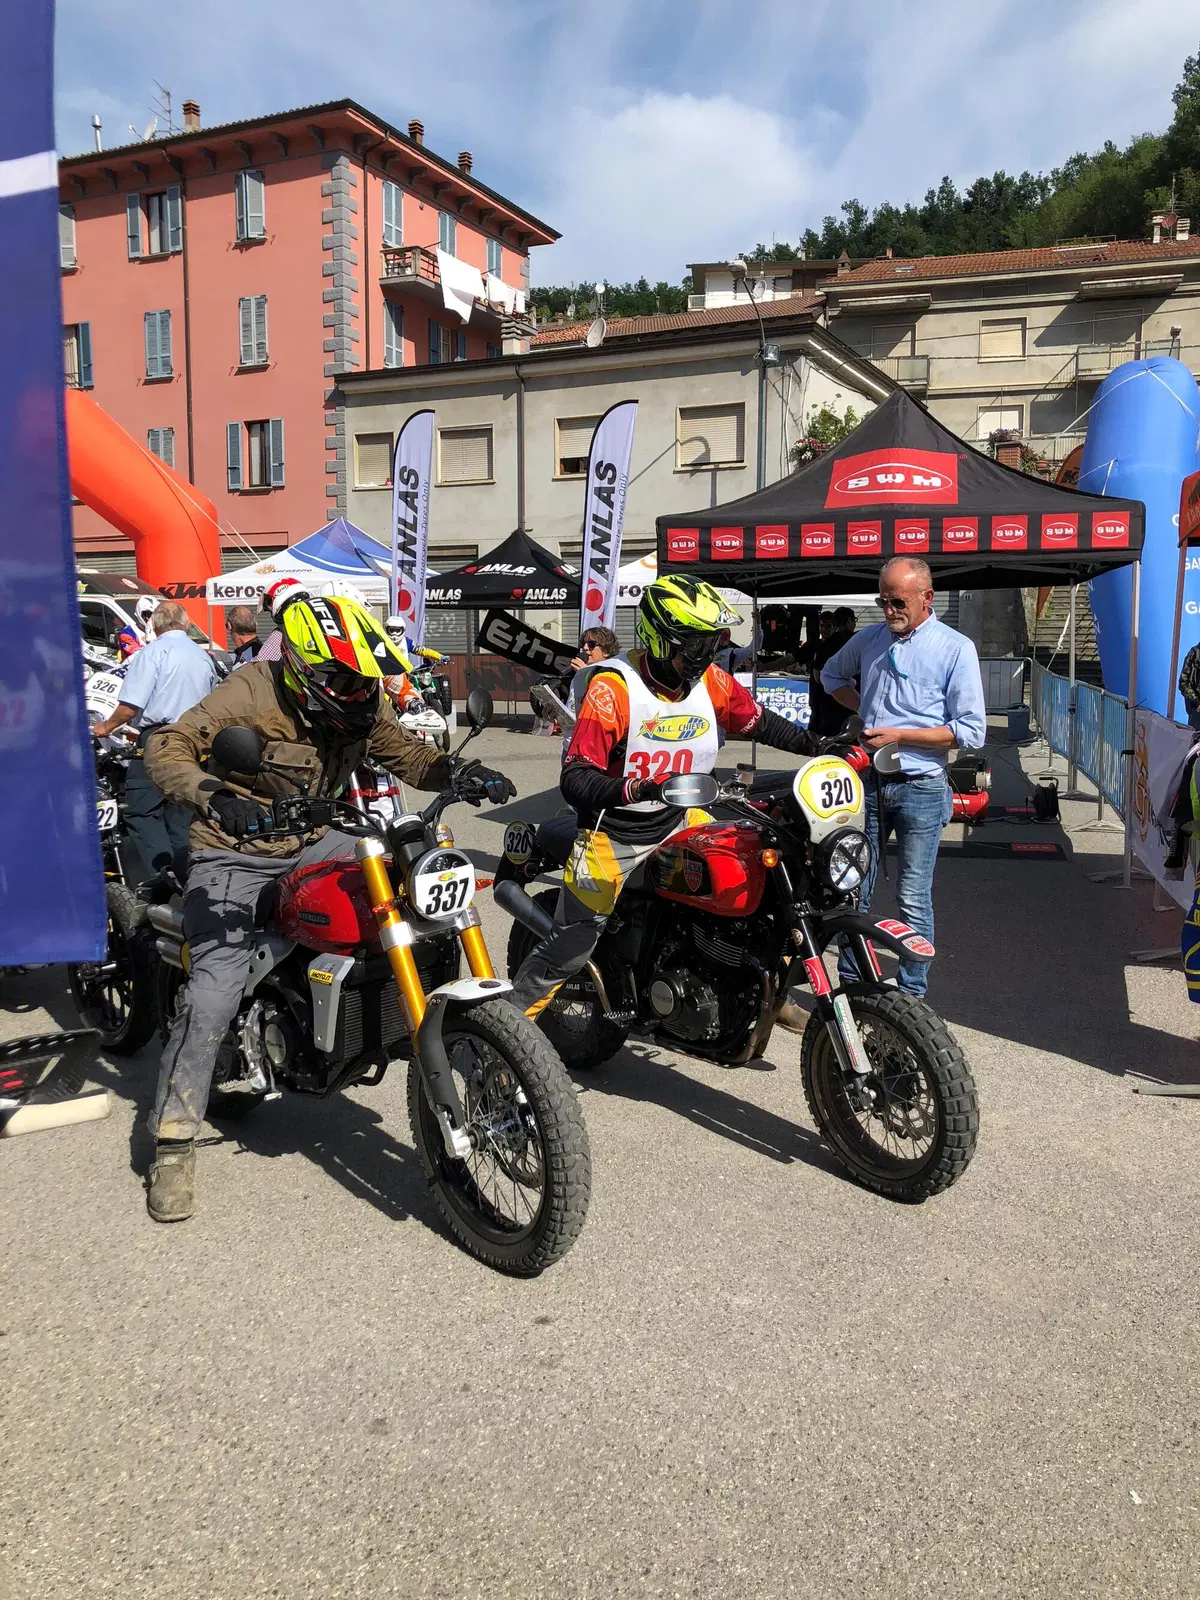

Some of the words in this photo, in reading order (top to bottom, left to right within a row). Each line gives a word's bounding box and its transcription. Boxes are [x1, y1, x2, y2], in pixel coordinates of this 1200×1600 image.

[618, 473, 629, 496] Only
[847, 473, 942, 489] SWM
[397, 465, 420, 583] ANLAS
[589, 460, 617, 581] ANLAS
[899, 532, 925, 540] SWM
[947, 530, 974, 538] SWM
[996, 529, 1024, 537] SWM
[1046, 527, 1074, 535] SWM
[1097, 525, 1125, 534] SWM
[715, 539, 740, 547] SWM
[760, 538, 785, 546] SWM
[478, 563, 537, 574] ANLAS
[158, 582, 206, 599] KTM
[525, 588, 567, 600] ANLAS
[311, 598, 341, 637] UFO
[93, 679, 117, 694] 326
[657, 724, 675, 733] M.C.
[678, 722, 707, 732] CHIEVE
[628, 748, 694, 779] 320
[821, 777, 853, 809] 320
[506, 831, 531, 854] 320
[425, 877, 469, 915] 337
